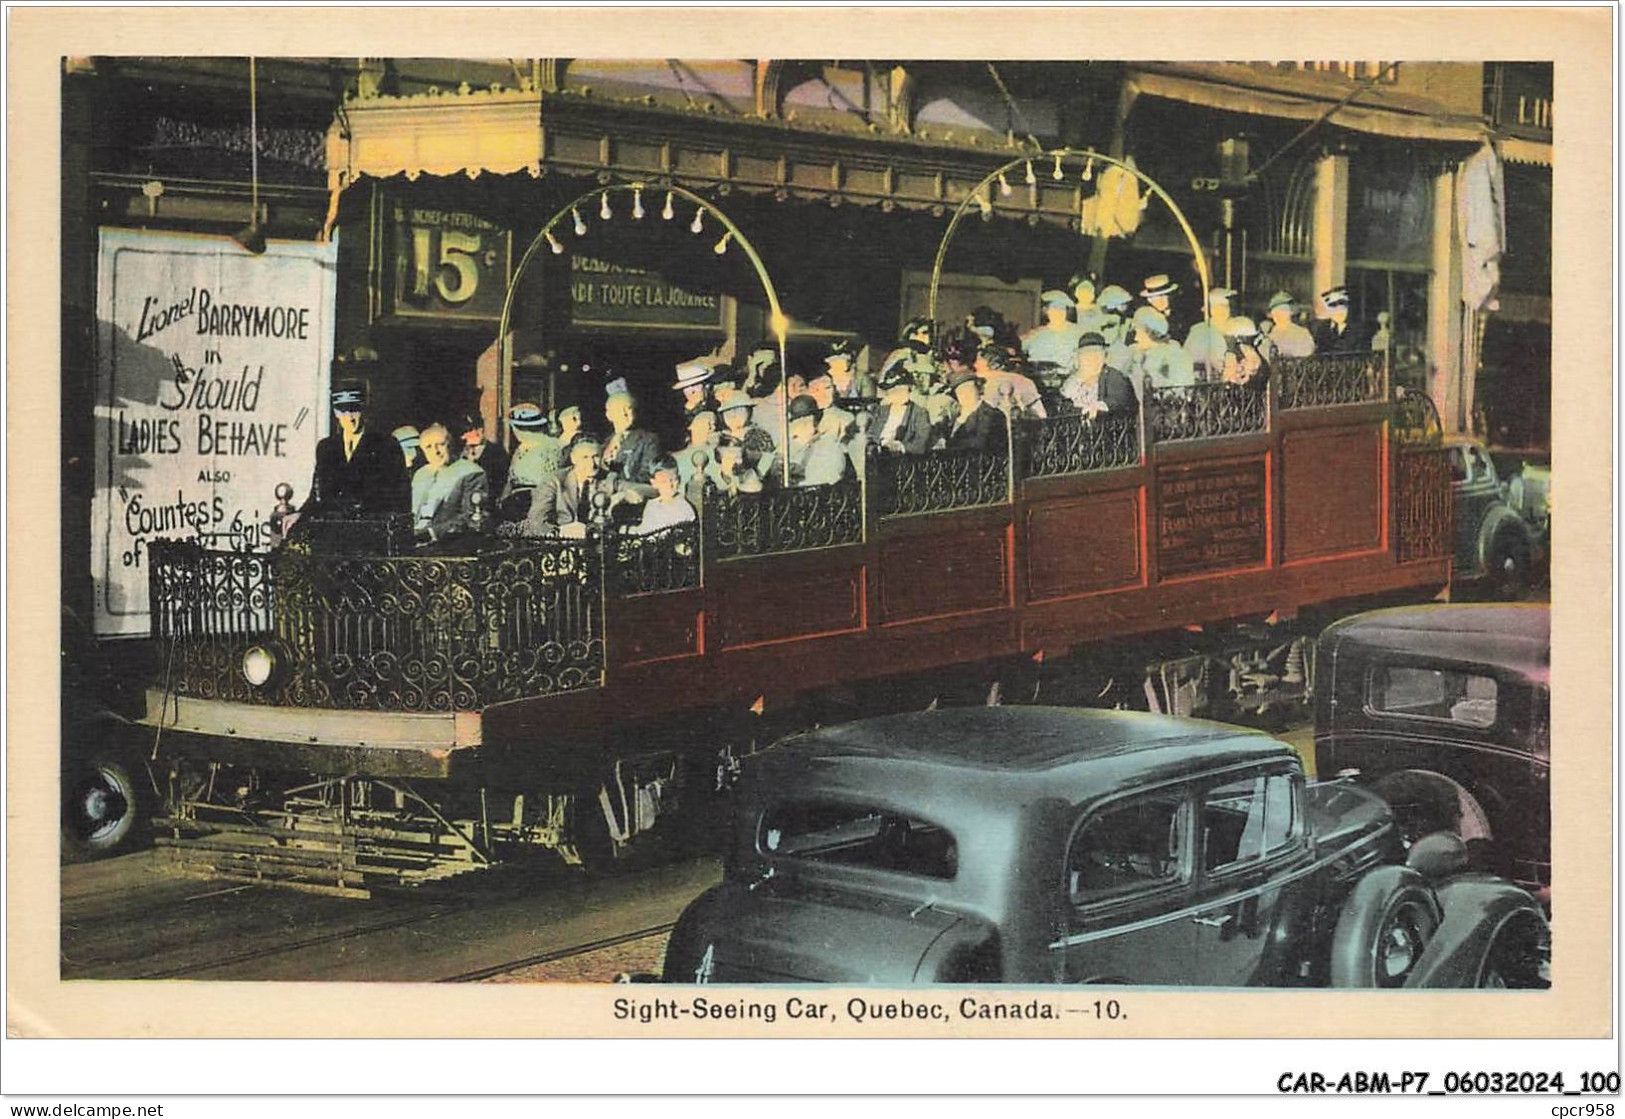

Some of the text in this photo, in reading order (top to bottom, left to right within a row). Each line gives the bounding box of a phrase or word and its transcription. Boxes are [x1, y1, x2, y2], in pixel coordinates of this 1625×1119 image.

[600, 283, 642, 306] TOUTE
[646, 285, 664, 306] LA
[136, 287, 309, 345] Lionel BARRYMORE
[117, 410, 182, 457] LADIES
[198, 470, 231, 483] ALSO
[123, 536, 146, 568] of
